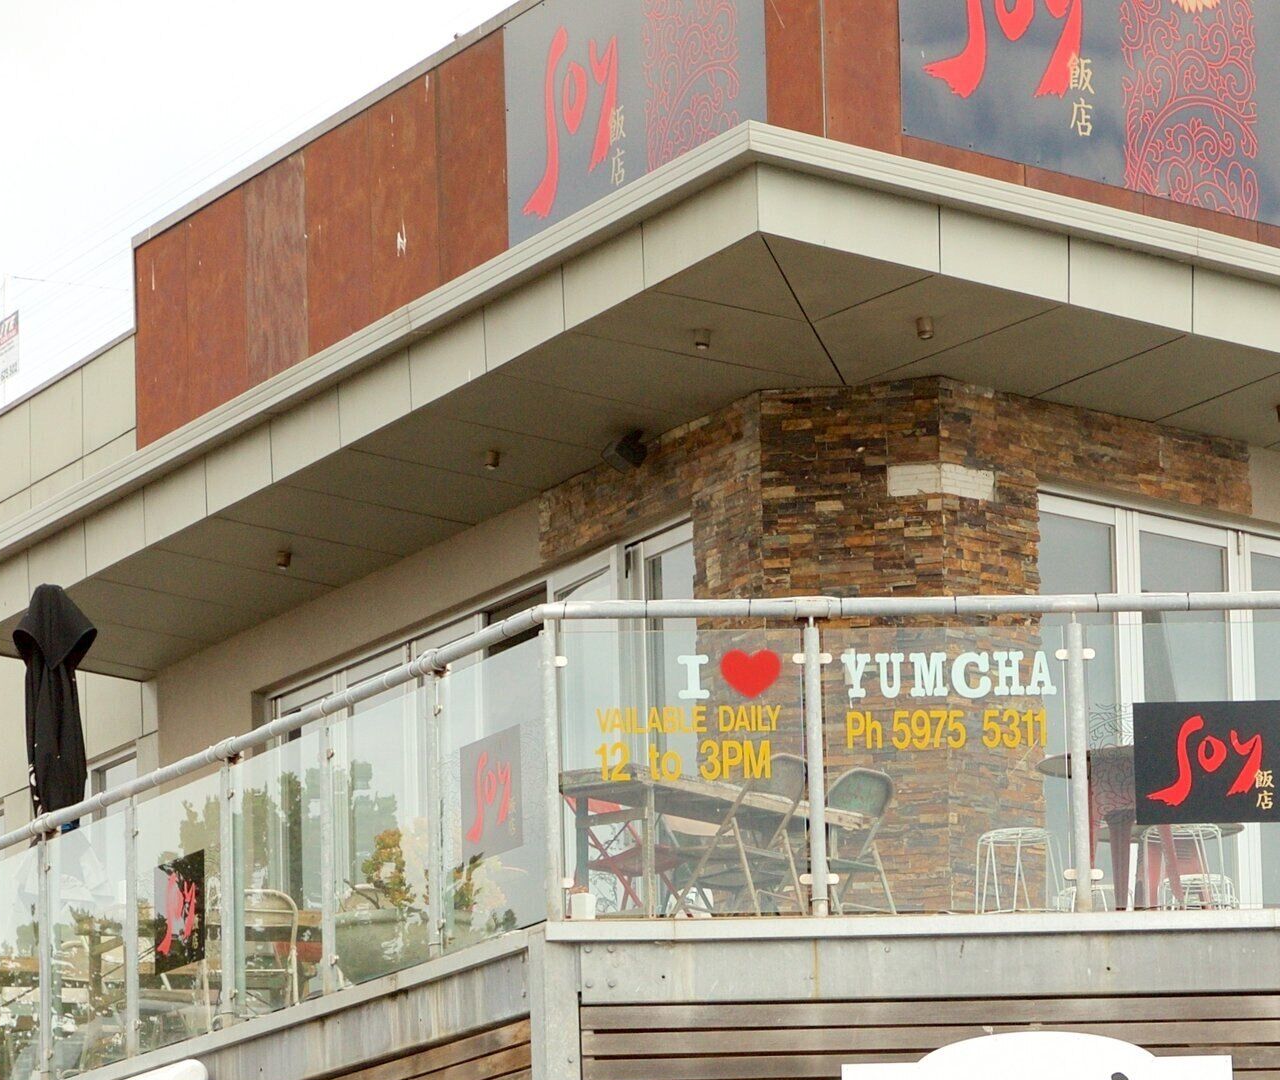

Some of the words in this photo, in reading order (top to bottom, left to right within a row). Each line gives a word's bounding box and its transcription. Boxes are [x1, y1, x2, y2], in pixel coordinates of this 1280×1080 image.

[1067, 52, 1095, 136] 飯店
[677, 654, 710, 699] I
[840, 650, 1058, 699] YUMCHA
[595, 705, 708, 734] VAILABLE
[718, 704, 781, 733] DAILY
[846, 711, 883, 750] Ph
[891, 709, 966, 750] 5975
[982, 708, 1048, 749] 5311
[595, 741, 631, 782] 12
[648, 742, 683, 782] to
[700, 739, 772, 781] 3PM
[1254, 769, 1275, 810] 飯店
